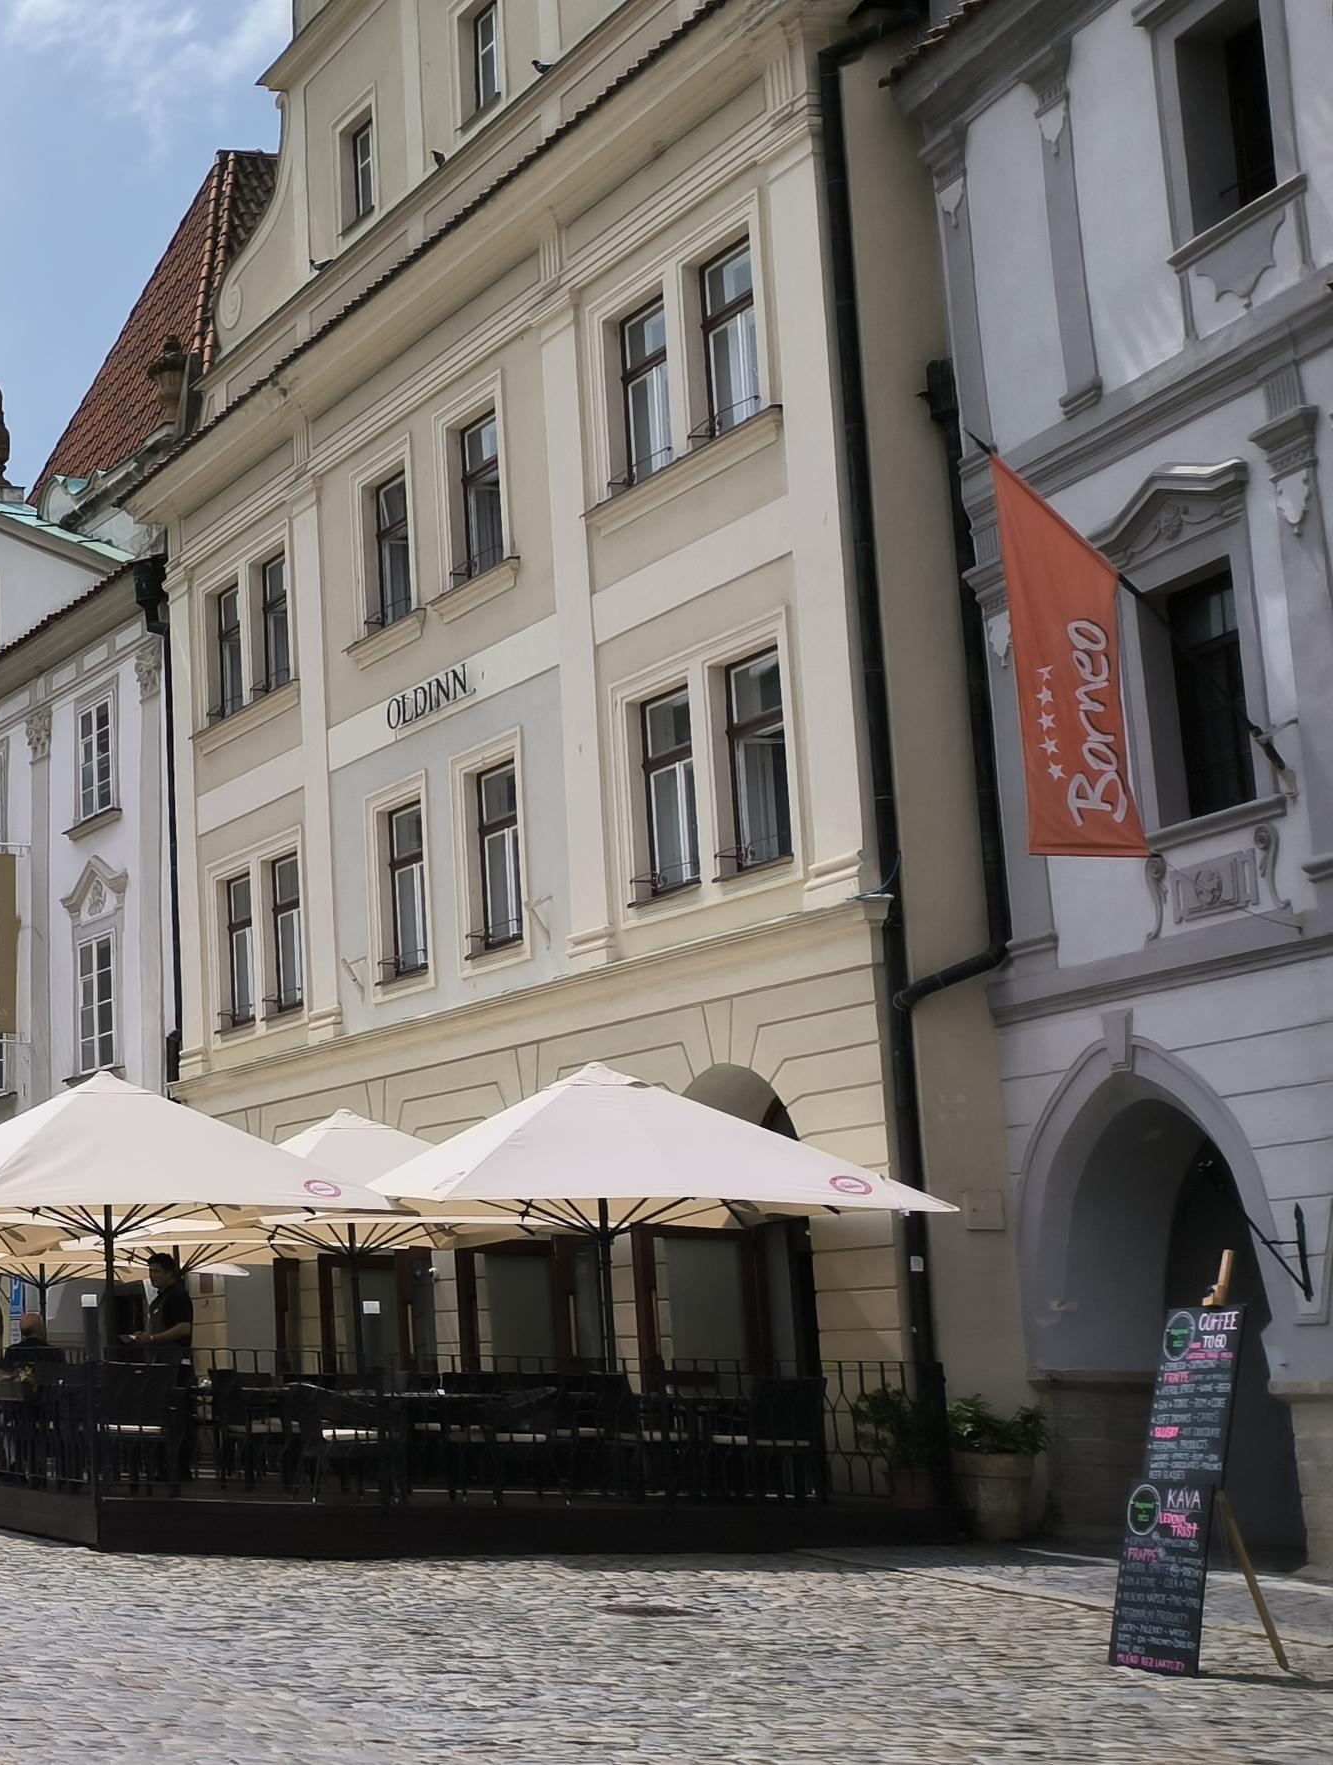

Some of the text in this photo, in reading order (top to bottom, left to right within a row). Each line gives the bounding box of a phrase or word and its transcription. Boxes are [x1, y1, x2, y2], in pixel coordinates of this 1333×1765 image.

[386, 662, 468, 730] OLDINN
[1066, 619, 1128, 827] Borneo
[1198, 1311, 1240, 1332] COFFEE
[1203, 1334, 1214, 1349] TO
[1214, 1333, 1227, 1349] GO
[1166, 1485, 1201, 1510] KÁVA
